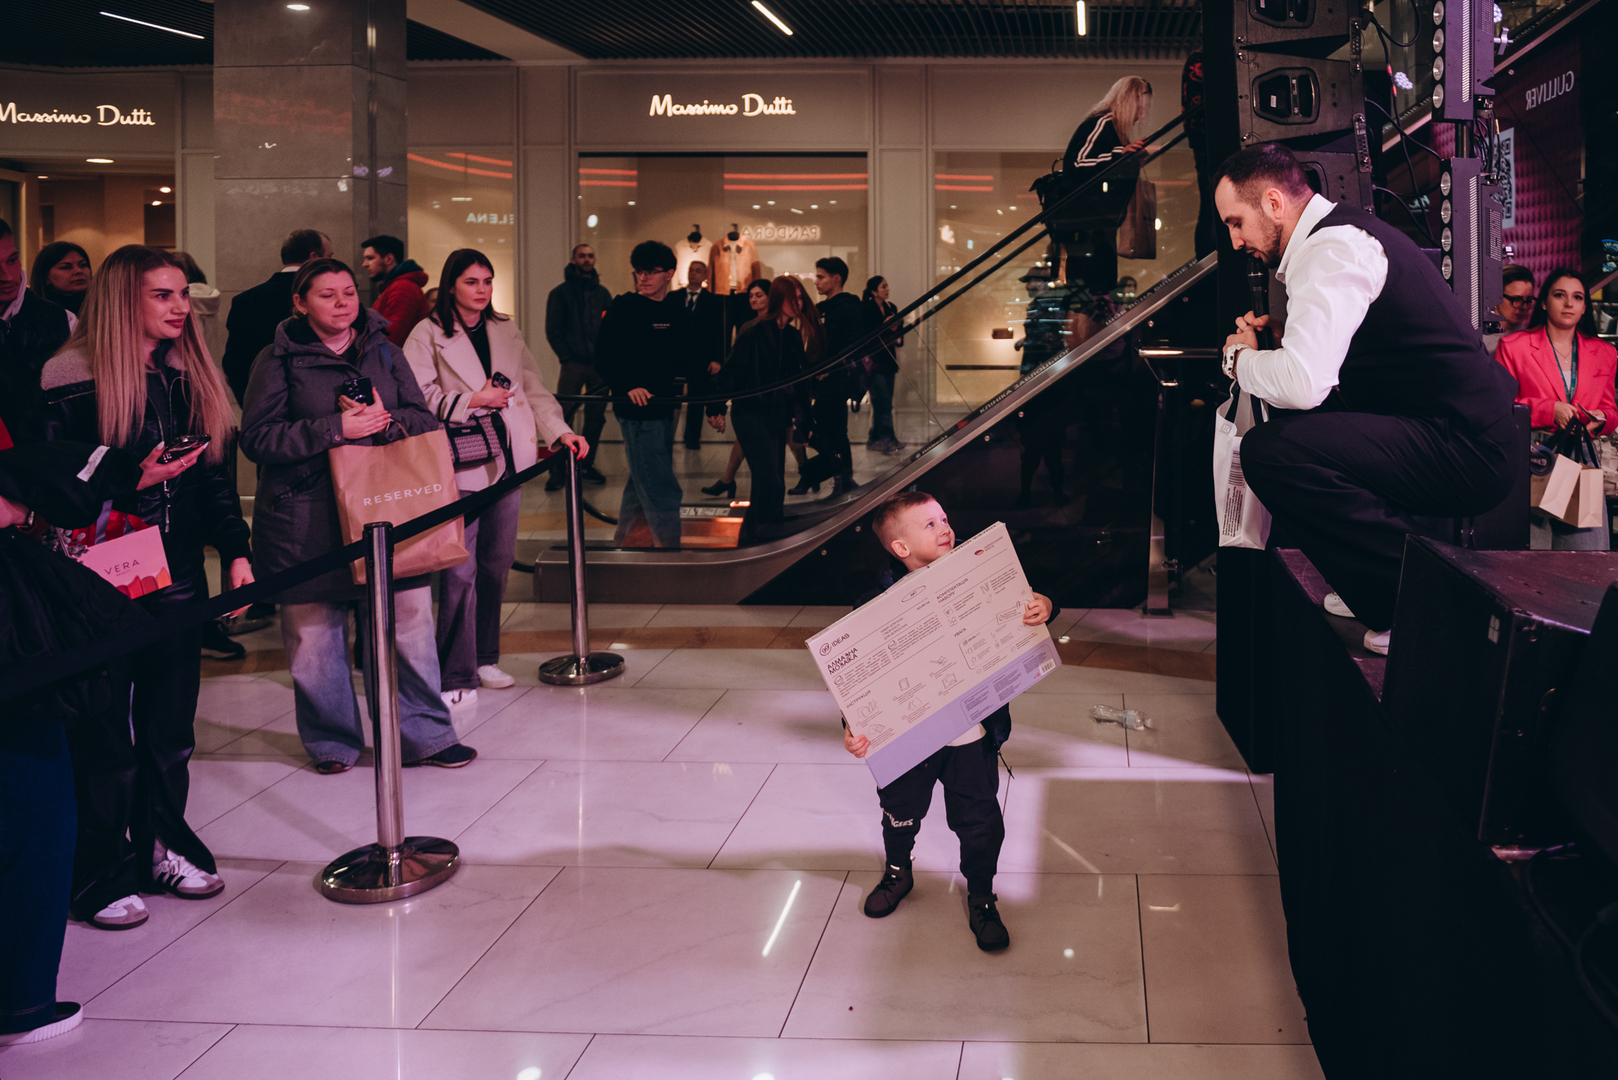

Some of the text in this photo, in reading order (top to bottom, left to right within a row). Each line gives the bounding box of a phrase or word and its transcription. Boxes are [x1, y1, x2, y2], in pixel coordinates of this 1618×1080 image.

[0, 102, 156, 126] Massimo Dutti
[649, 93, 796, 117] Massimo Dutti
[978, 348, 1070, 413] КЛІНІКА ЗАБЛОЦЬКОГ
[363, 484, 442, 506] RESERVED
[104, 560, 140, 575] VERA
[832, 633, 850, 647] IDEAS
[828, 648, 858, 669] АЛМАЗНА
